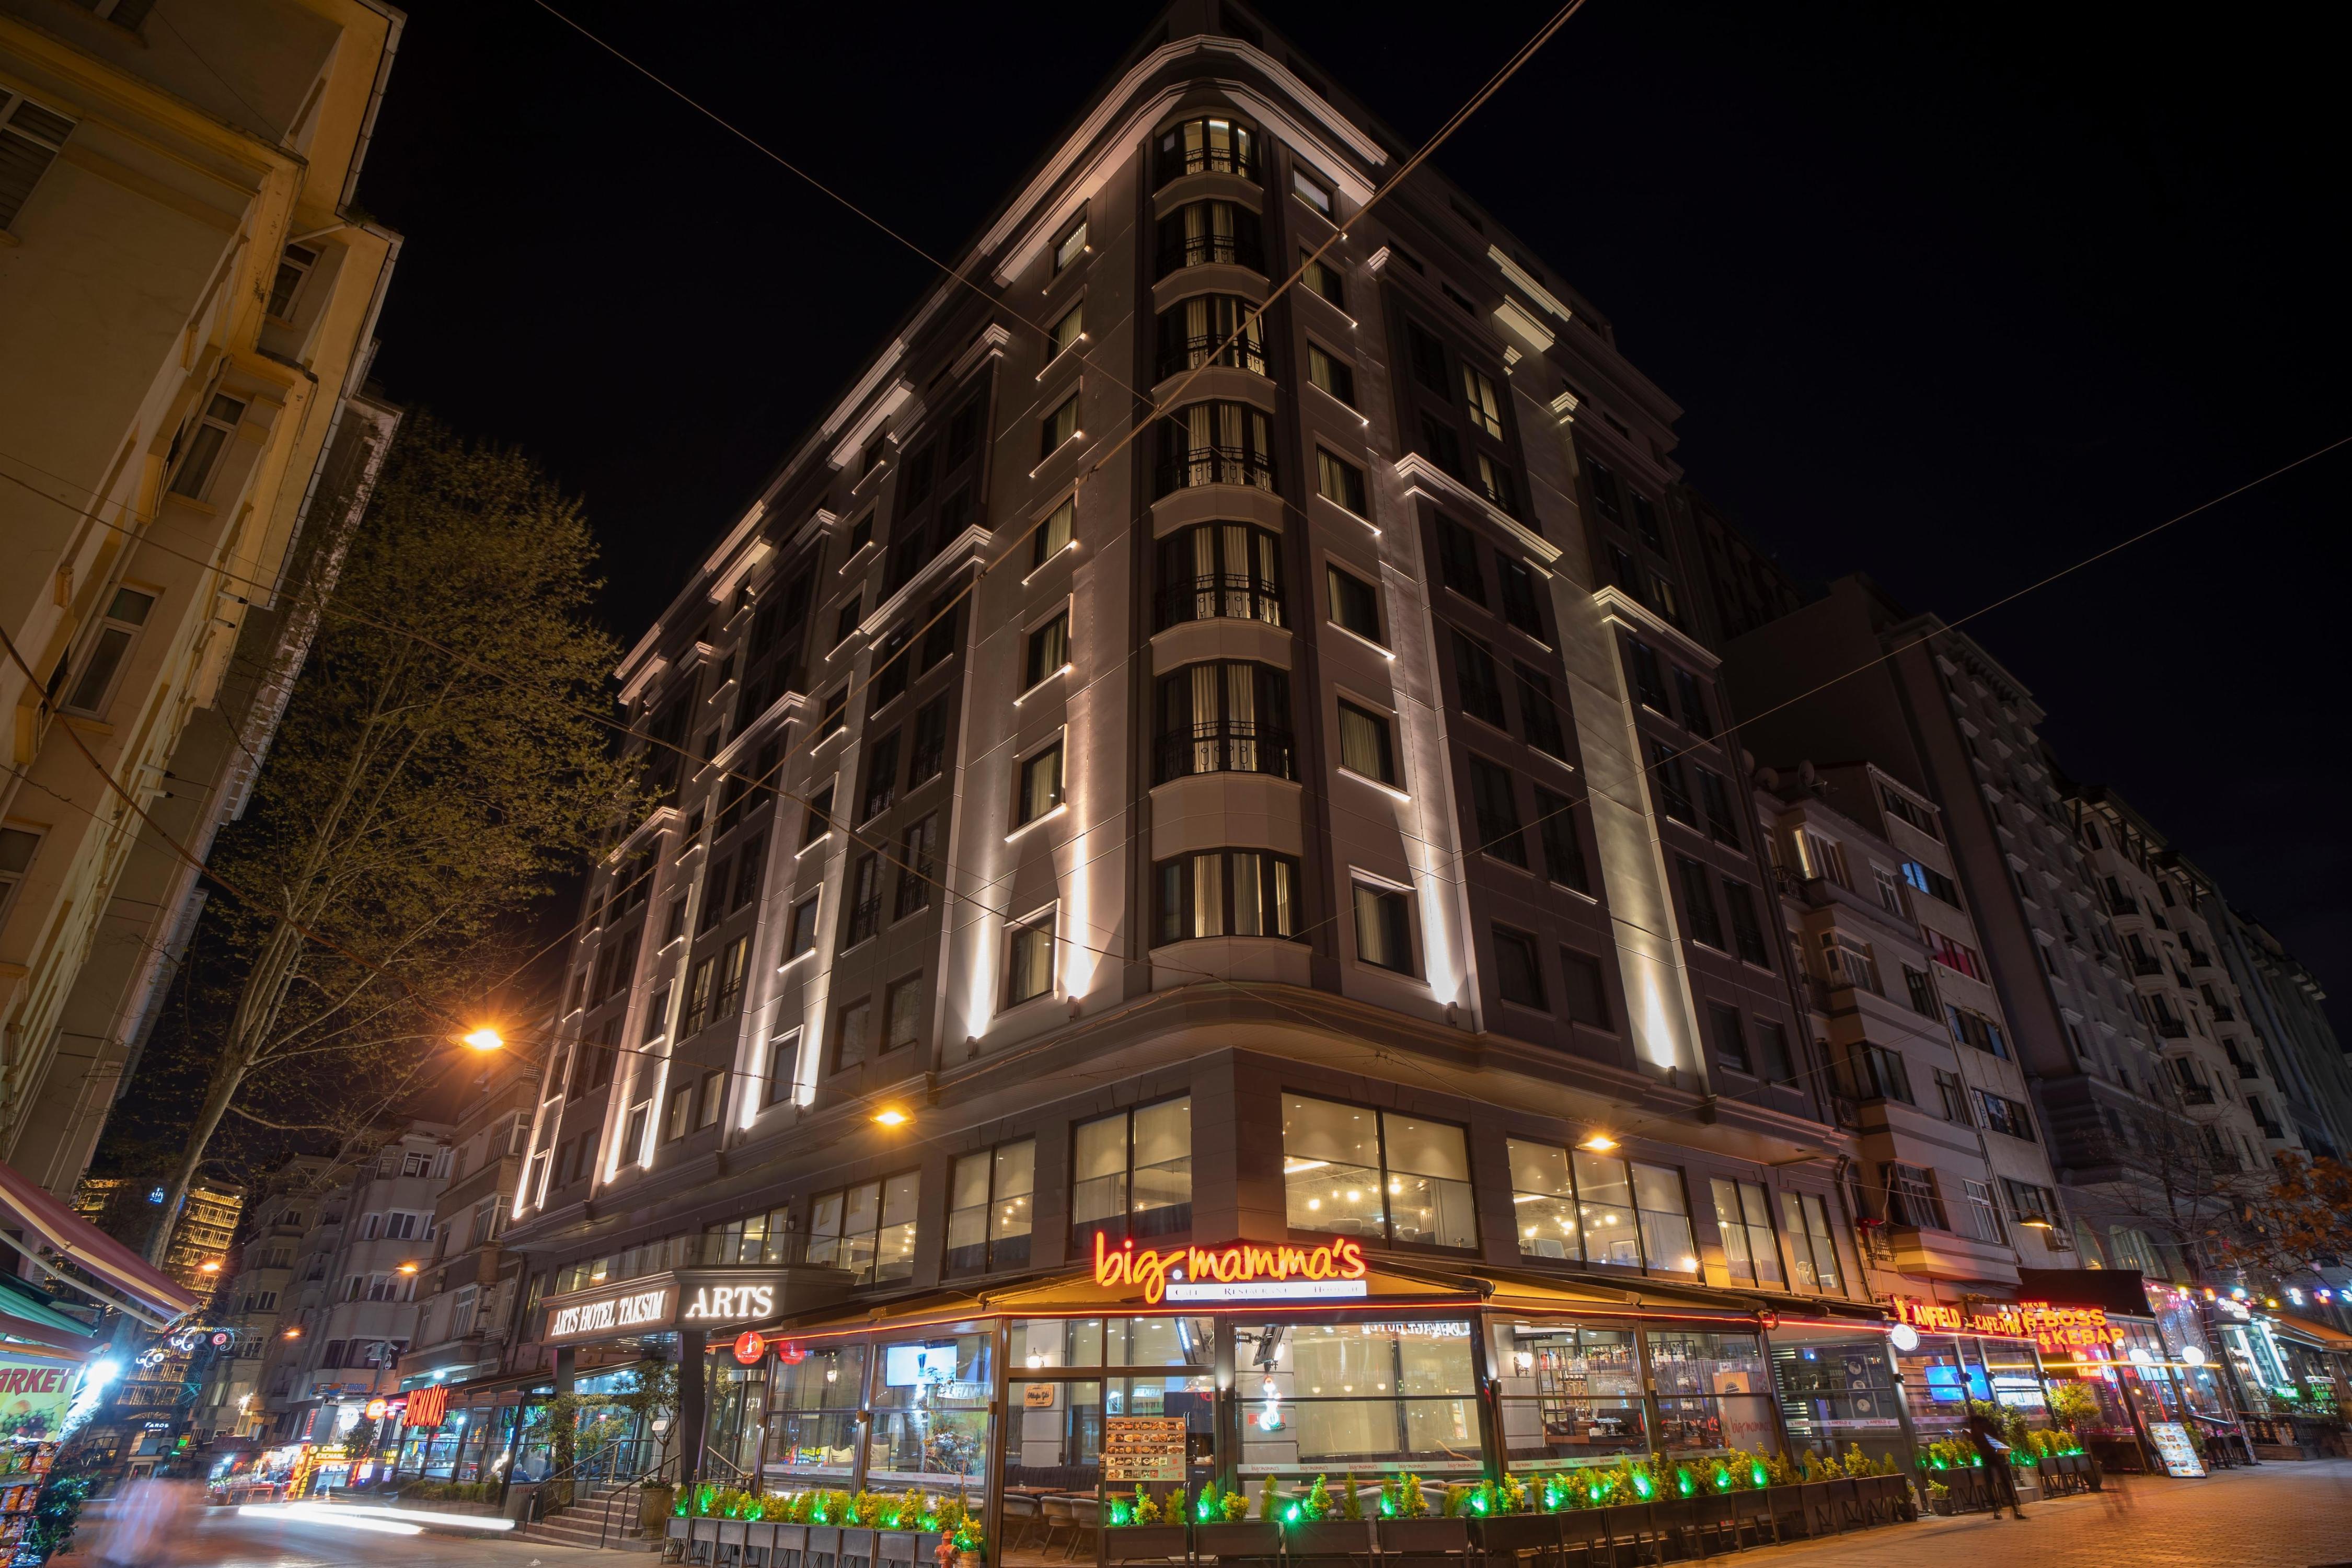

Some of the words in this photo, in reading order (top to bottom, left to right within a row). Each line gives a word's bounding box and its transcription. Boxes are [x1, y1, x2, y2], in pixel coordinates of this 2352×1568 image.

[551, 1307, 580, 1336] ARTS
[578, 1300, 616, 1332] HOTEL
[618, 1290, 665, 1325] TAKSIM
[685, 1286, 773, 1318] ARTS
[1912, 1304, 1962, 1333] ANFIELD
[1975, 1315, 2001, 1334] CAFE
[2042, 1309, 2107, 1328] BOSS
[2039, 1333, 2051, 1345] &
[2051, 1328, 2125, 1345] KEBAP
